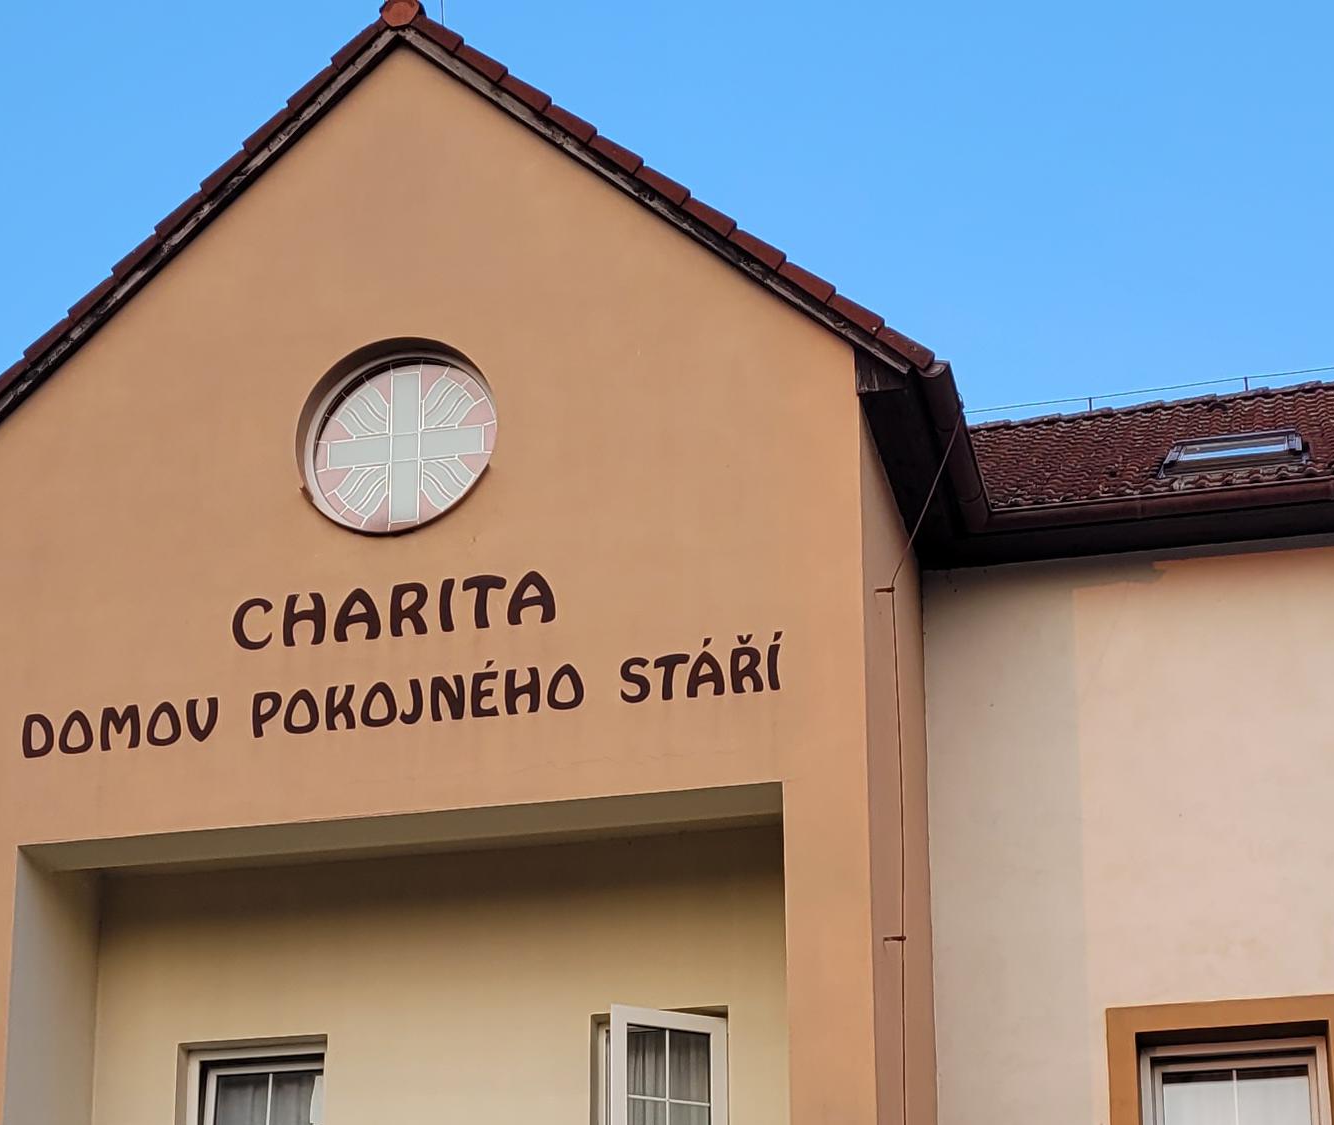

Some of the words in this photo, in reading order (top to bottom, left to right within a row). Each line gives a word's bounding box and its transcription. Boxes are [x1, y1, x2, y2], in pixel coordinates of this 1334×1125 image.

[232, 570, 557, 650] CHARITA
[21, 696, 220, 759] DOMOV
[252, 659, 585, 739] POKOJNÉHO
[619, 630, 783, 704] STÁŘÍ
